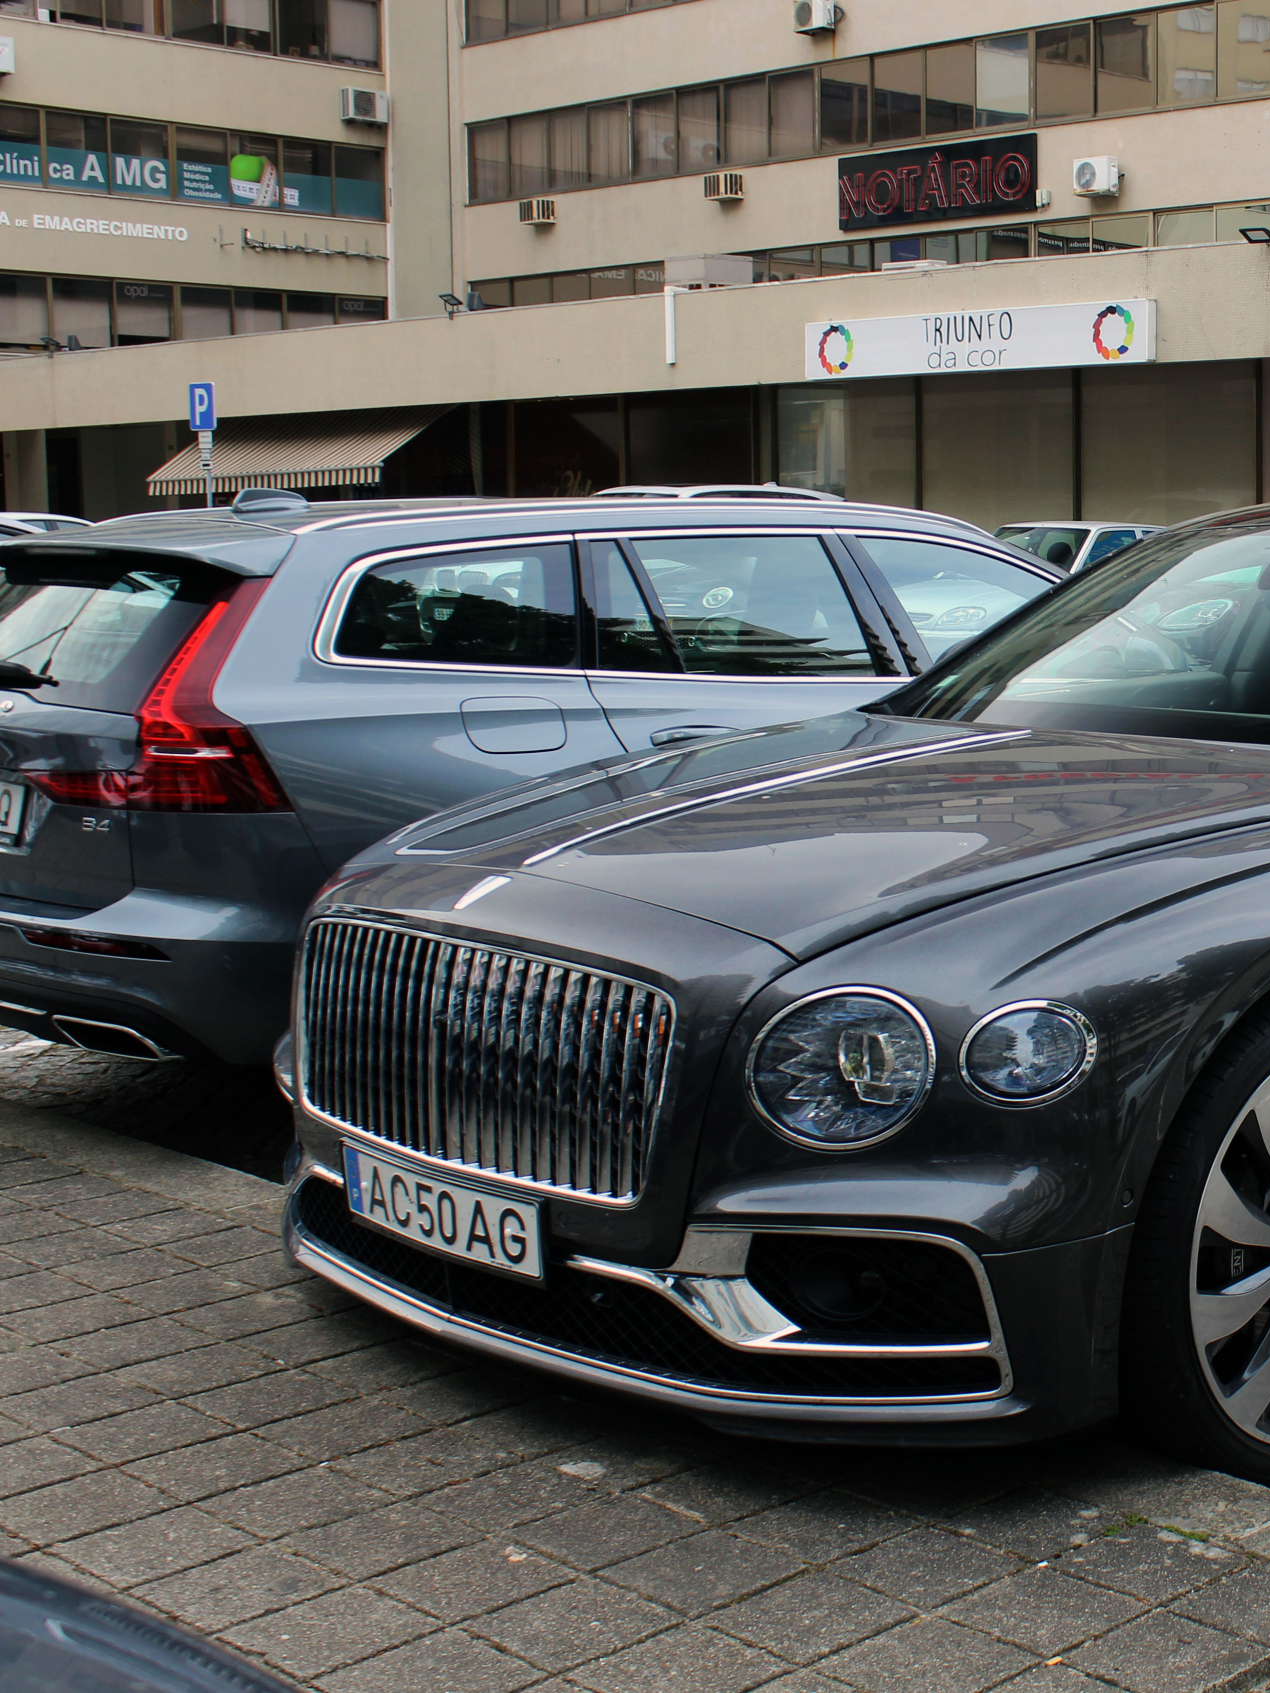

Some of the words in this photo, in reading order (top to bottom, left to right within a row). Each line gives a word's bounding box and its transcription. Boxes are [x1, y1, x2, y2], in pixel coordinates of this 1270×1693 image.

[183, 162, 212, 173] Estética
[183, 171, 210, 181] Médica
[183, 180, 215, 190] Nutrição
[839, 151, 1031, 220] NOTÁRIO
[183, 188, 222, 199] Obesidade
[15, 219, 29, 228] DE
[33, 213, 188, 242] EMAGRECIMENTO
[124, 285, 148, 298] opal
[343, 300, 365, 312] opal
[922, 311, 1013, 347] TRIUNFO
[927, 345, 957, 369] da
[966, 348, 1008, 368] cor
[194, 388, 209, 426] P
[82, 816, 111, 833] B4
